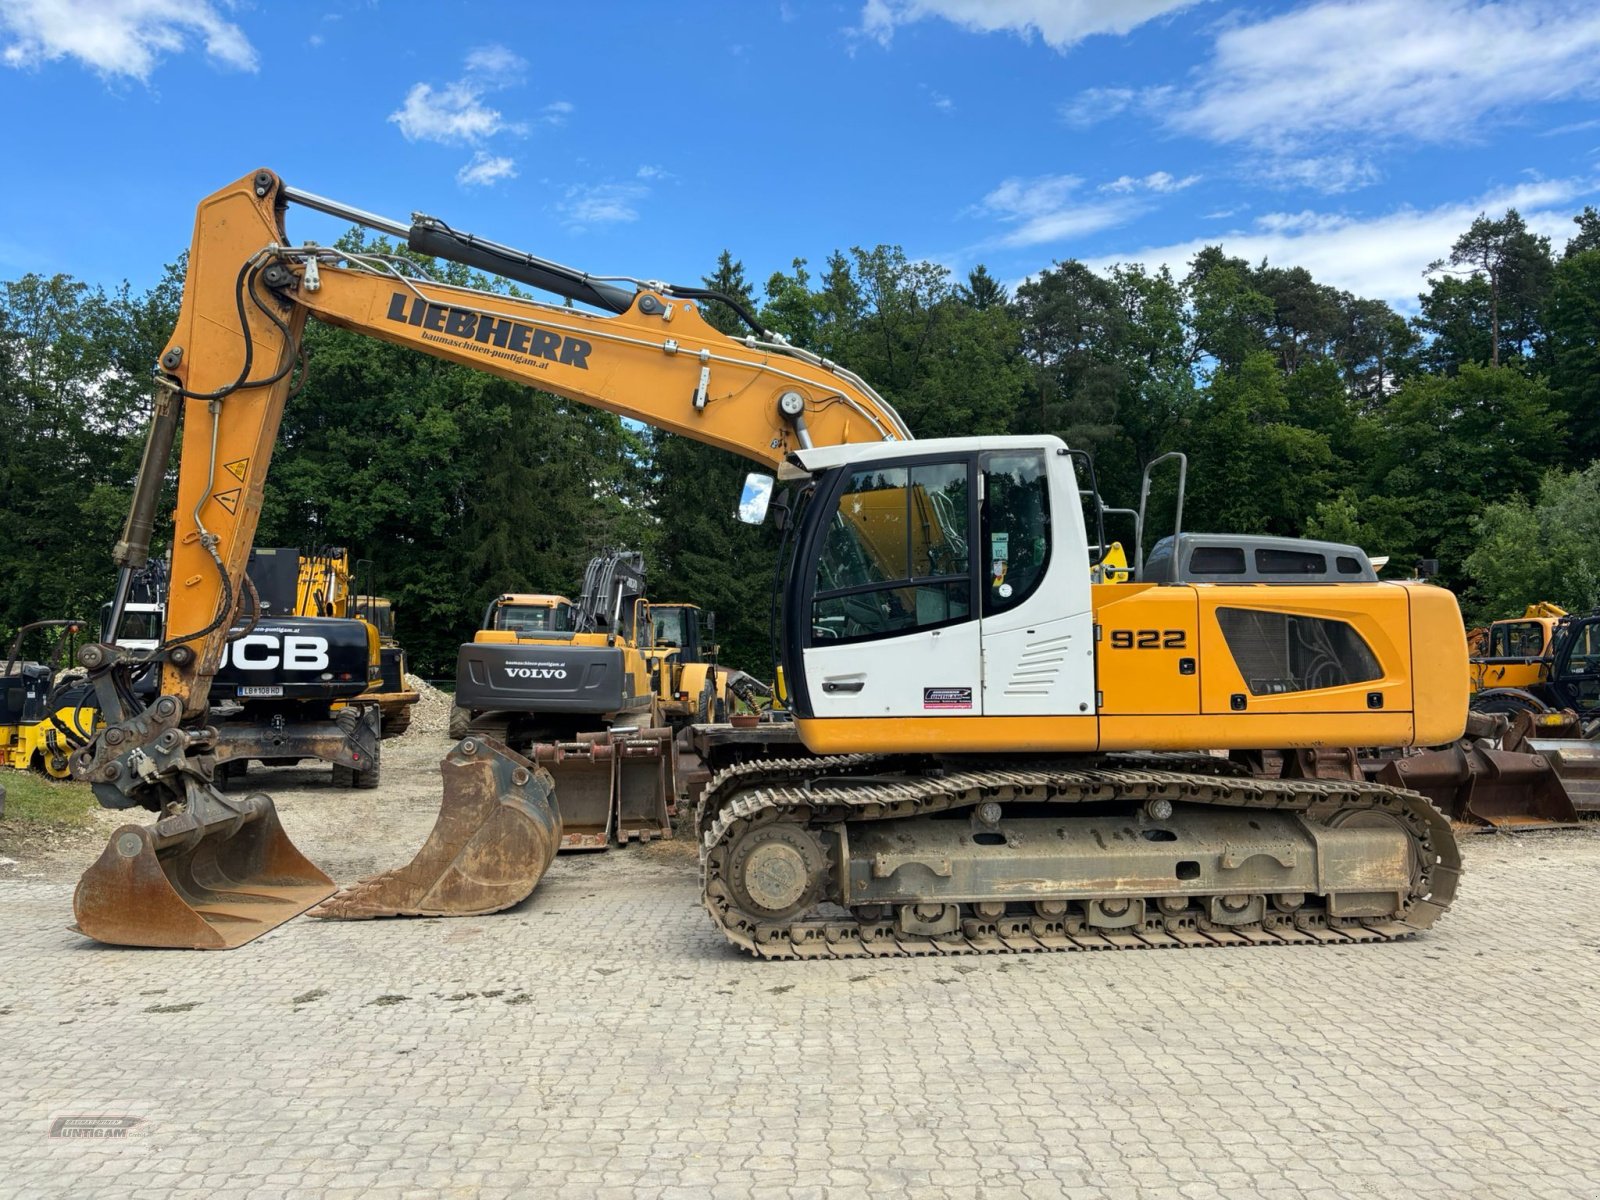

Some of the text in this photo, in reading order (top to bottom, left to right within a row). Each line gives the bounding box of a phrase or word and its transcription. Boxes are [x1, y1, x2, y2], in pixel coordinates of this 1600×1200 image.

[387, 292, 592, 370] LIEBHERR
[421, 331, 549, 370] baumaschinen-puntigam.at
[1110, 629, 1187, 650] 922
[504, 667, 567, 679] VOLVO
[244, 687, 253, 695] LB
